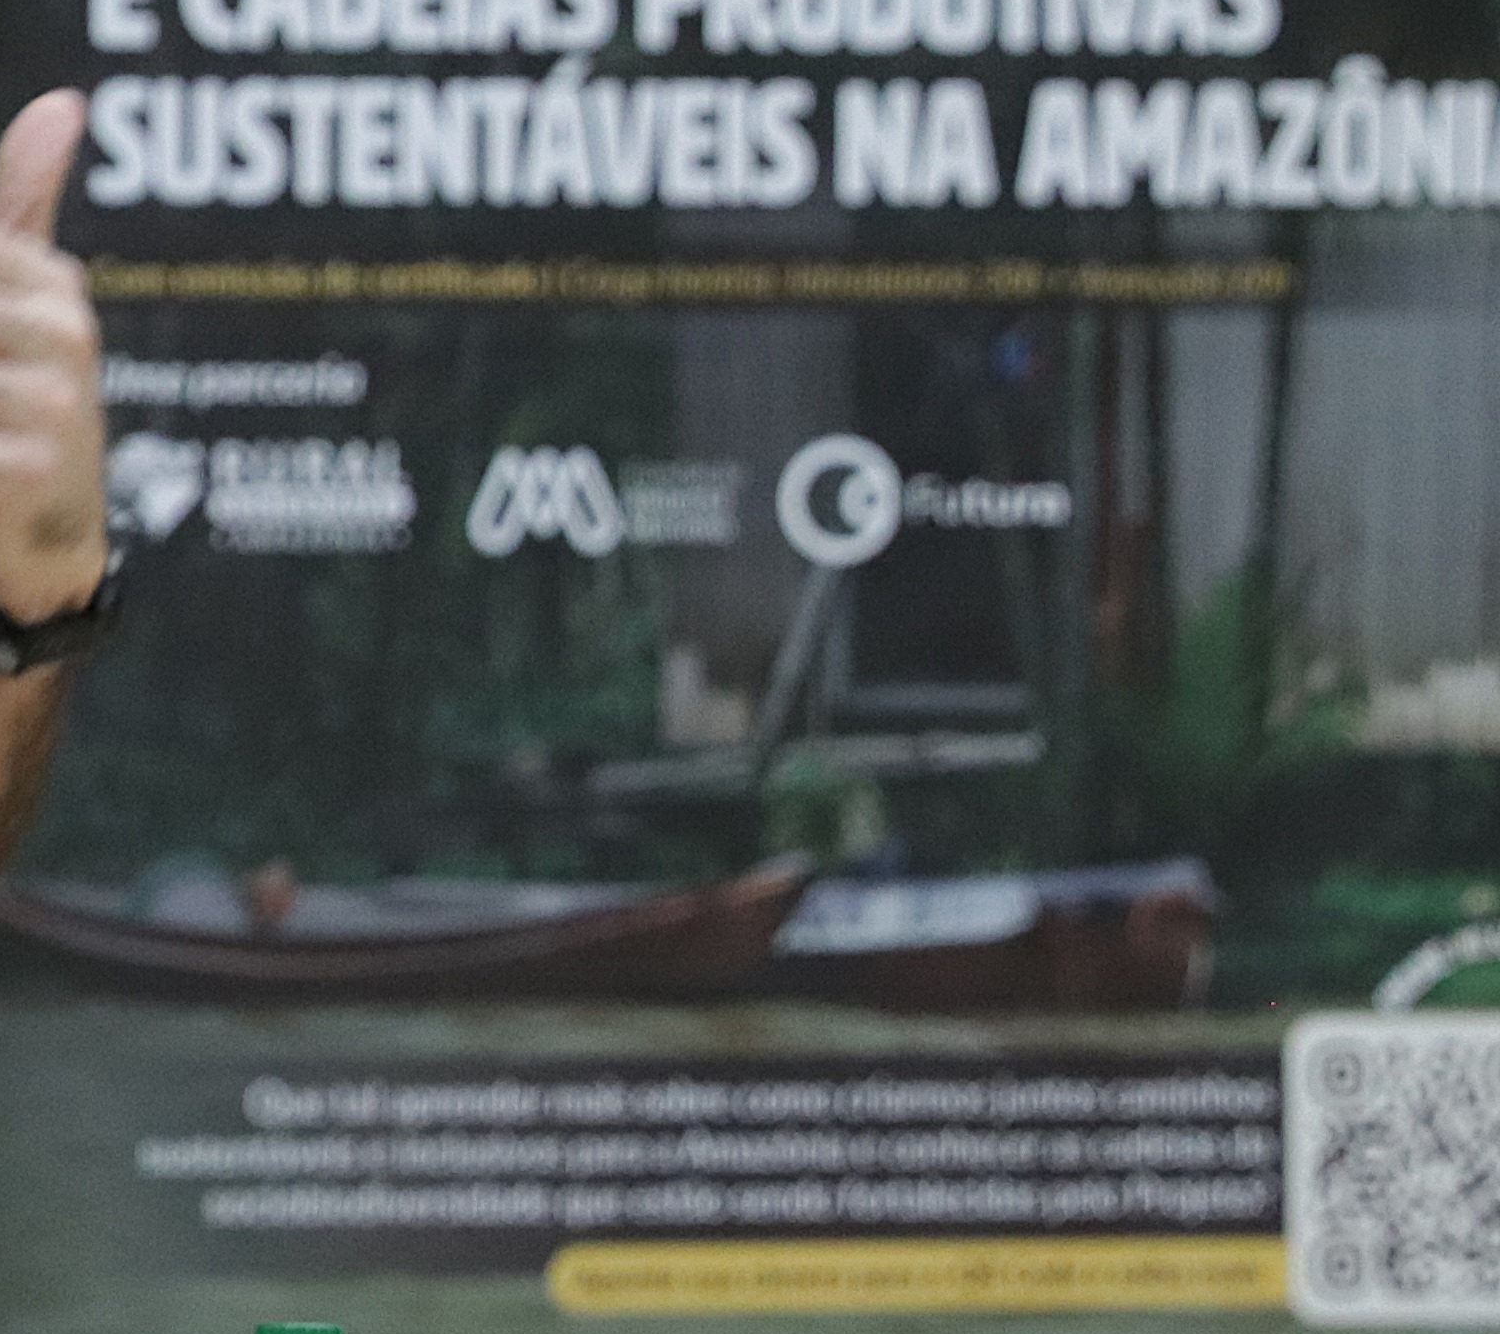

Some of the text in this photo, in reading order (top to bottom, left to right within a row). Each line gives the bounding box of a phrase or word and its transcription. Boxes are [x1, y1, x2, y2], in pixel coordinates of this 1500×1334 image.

[88, 53, 1500, 208] SUSTENTÁVEIS NA AMAZÔNI
[902, 473, 1072, 528] Futura
